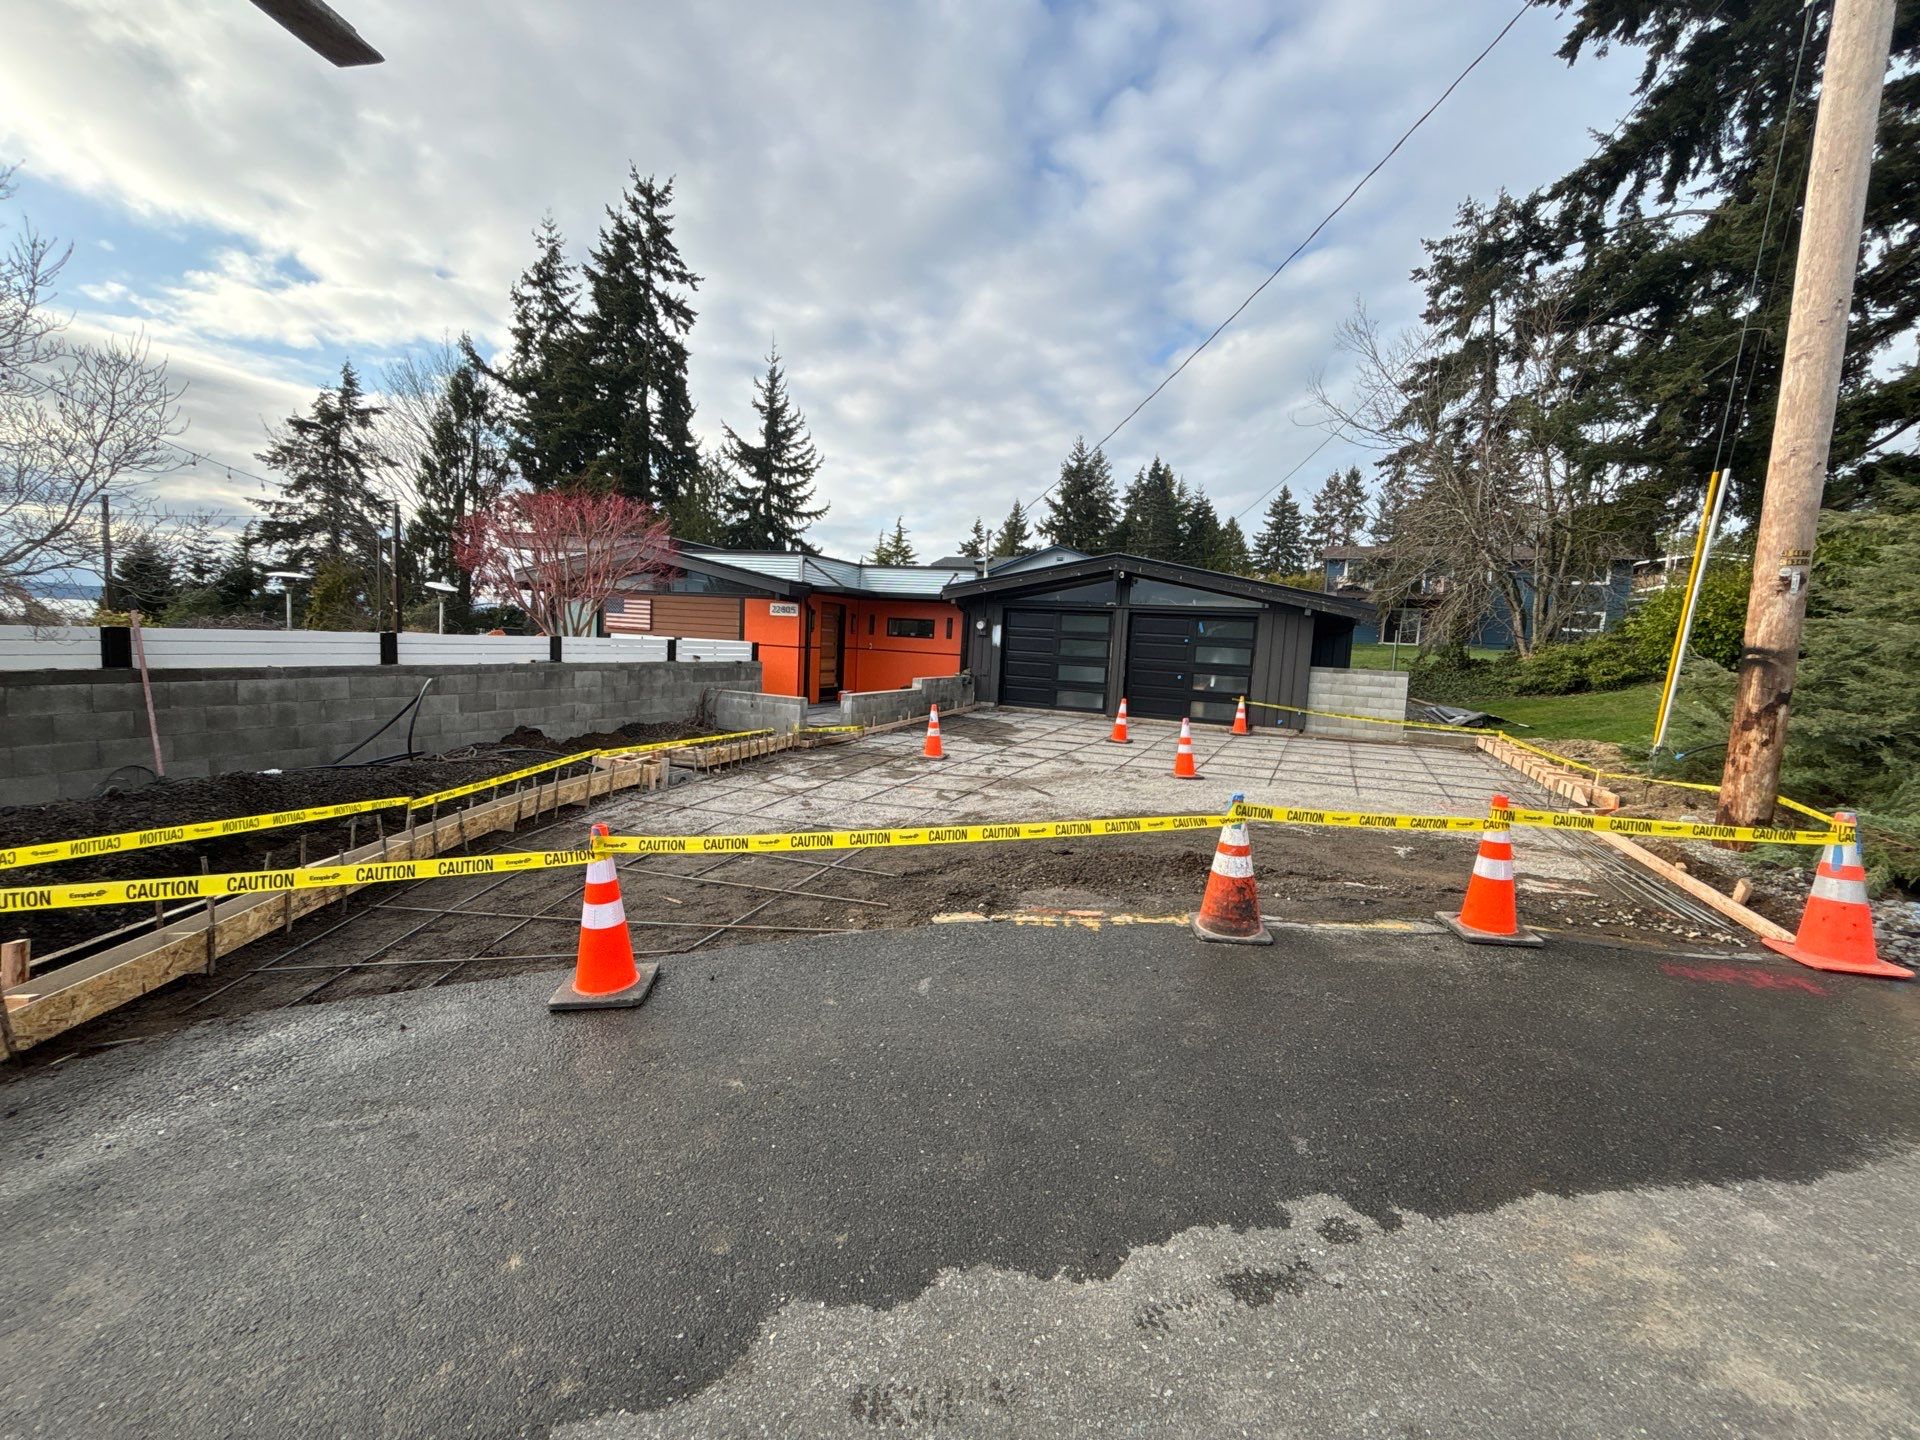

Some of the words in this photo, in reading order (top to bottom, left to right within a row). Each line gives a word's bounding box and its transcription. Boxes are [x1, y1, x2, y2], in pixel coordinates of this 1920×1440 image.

[771, 605, 796, 614] 22805
[1235, 805, 1273, 819] CAUTION
[1287, 811, 1324, 823] CAUTION
[1359, 816, 1397, 827] CAUTION
[1410, 818, 1448, 829] CAUTION
[1553, 815, 1594, 828] CAUTION
[1610, 820, 1652, 832] CAUTION
[1692, 825, 1736, 837] CAUTION
[1752, 828, 1796, 840] CAUTION
[638, 840, 685, 851] CAUTION
[703, 838, 748, 850] CAUTION
[791, 835, 833, 847] CAUTION
[849, 832, 890, 845] CAUTION
[928, 829, 967, 841] CAUTION
[982, 827, 1020, 839] CAUTION
[1055, 823, 1091, 835] CAUTION
[1105, 820, 1140, 832] CAUTION
[1173, 817, 1207, 828] CAUTION
[0, 890, 52, 909] UTION
[126, 880, 199, 899] CAUTION
[227, 873, 294, 892] CAUTION
[356, 864, 415, 882] CAUTION
[438, 858, 493, 875] CAUTION
[545, 850, 595, 866] CAUTION
